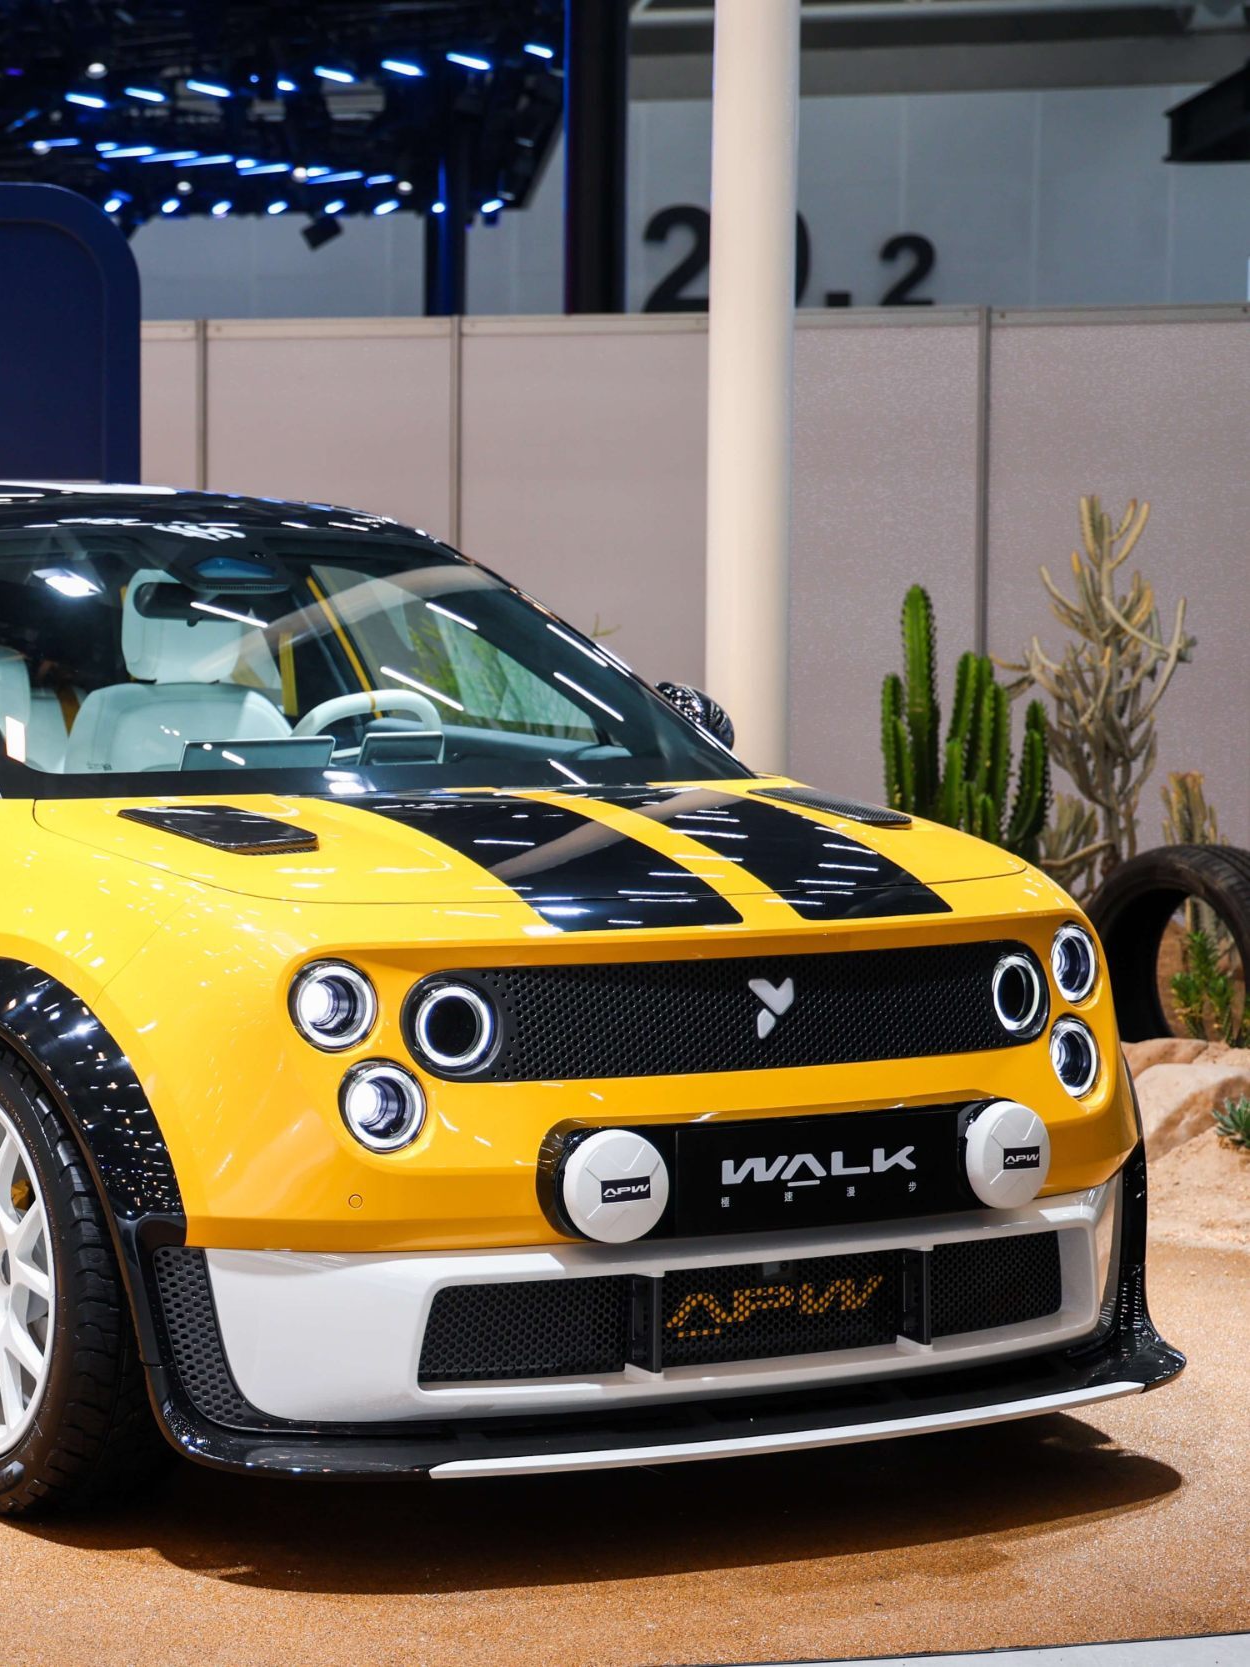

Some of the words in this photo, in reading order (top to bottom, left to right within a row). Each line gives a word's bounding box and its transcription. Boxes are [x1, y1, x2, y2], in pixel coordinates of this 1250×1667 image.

[643, 205, 937, 312] 2.2
[721, 1145, 917, 1187] WALK
[1004, 1153, 1040, 1165] APW
[603, 1183, 650, 1198] APW
[665, 1274, 884, 1339] APW
